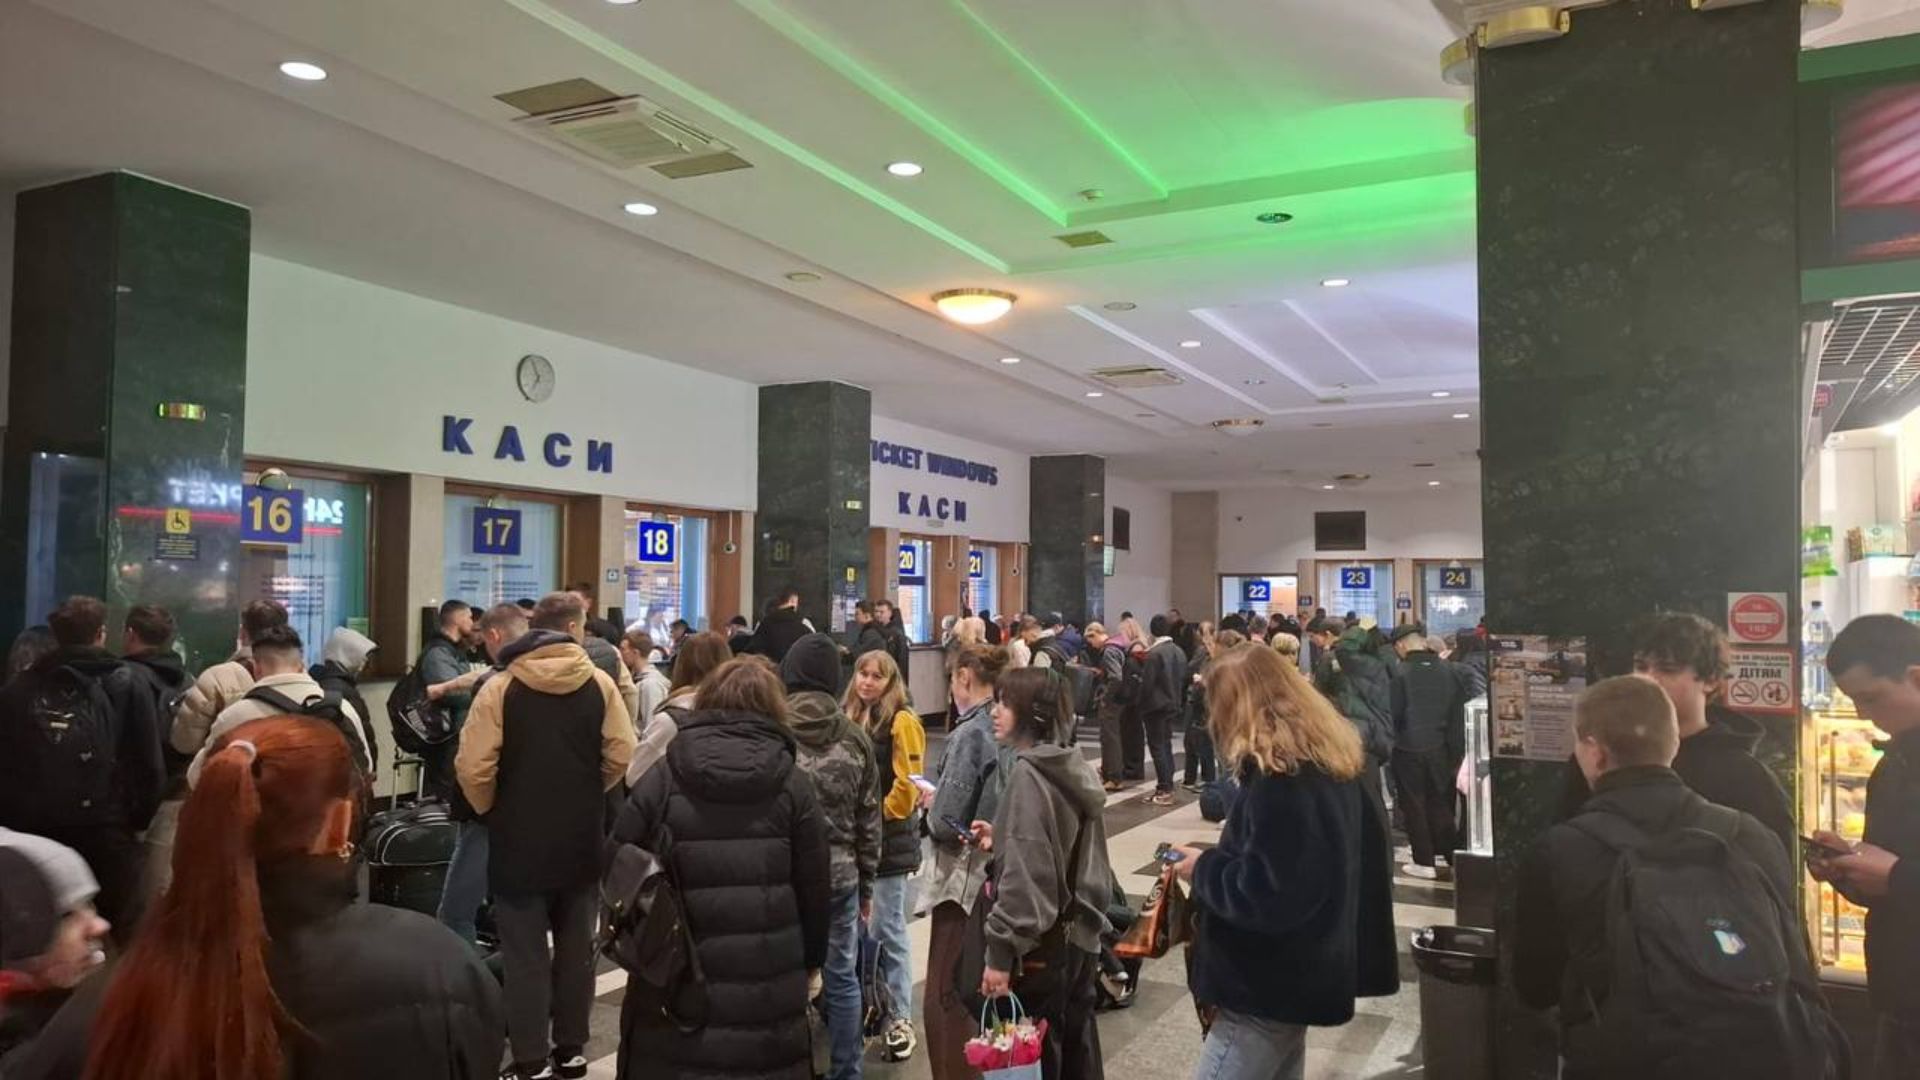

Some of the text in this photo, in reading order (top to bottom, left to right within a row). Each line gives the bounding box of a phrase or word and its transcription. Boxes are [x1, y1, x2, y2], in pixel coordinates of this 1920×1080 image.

[442, 415, 613, 473] КАСИ
[870, 440, 998, 486] ICKET WINDOWS
[247, 495, 292, 534] 16
[898, 491, 967, 522] КАСИ
[481, 518, 513, 547] 17
[643, 529, 669, 556] 18
[899, 551, 914, 569] 20
[969, 556, 981, 573] 21
[1346, 572, 1366, 585] 23
[1445, 572, 1466, 586] 24
[1248, 585, 1266, 598] 22
[1738, 667, 1782, 679] ДІТЯМ
